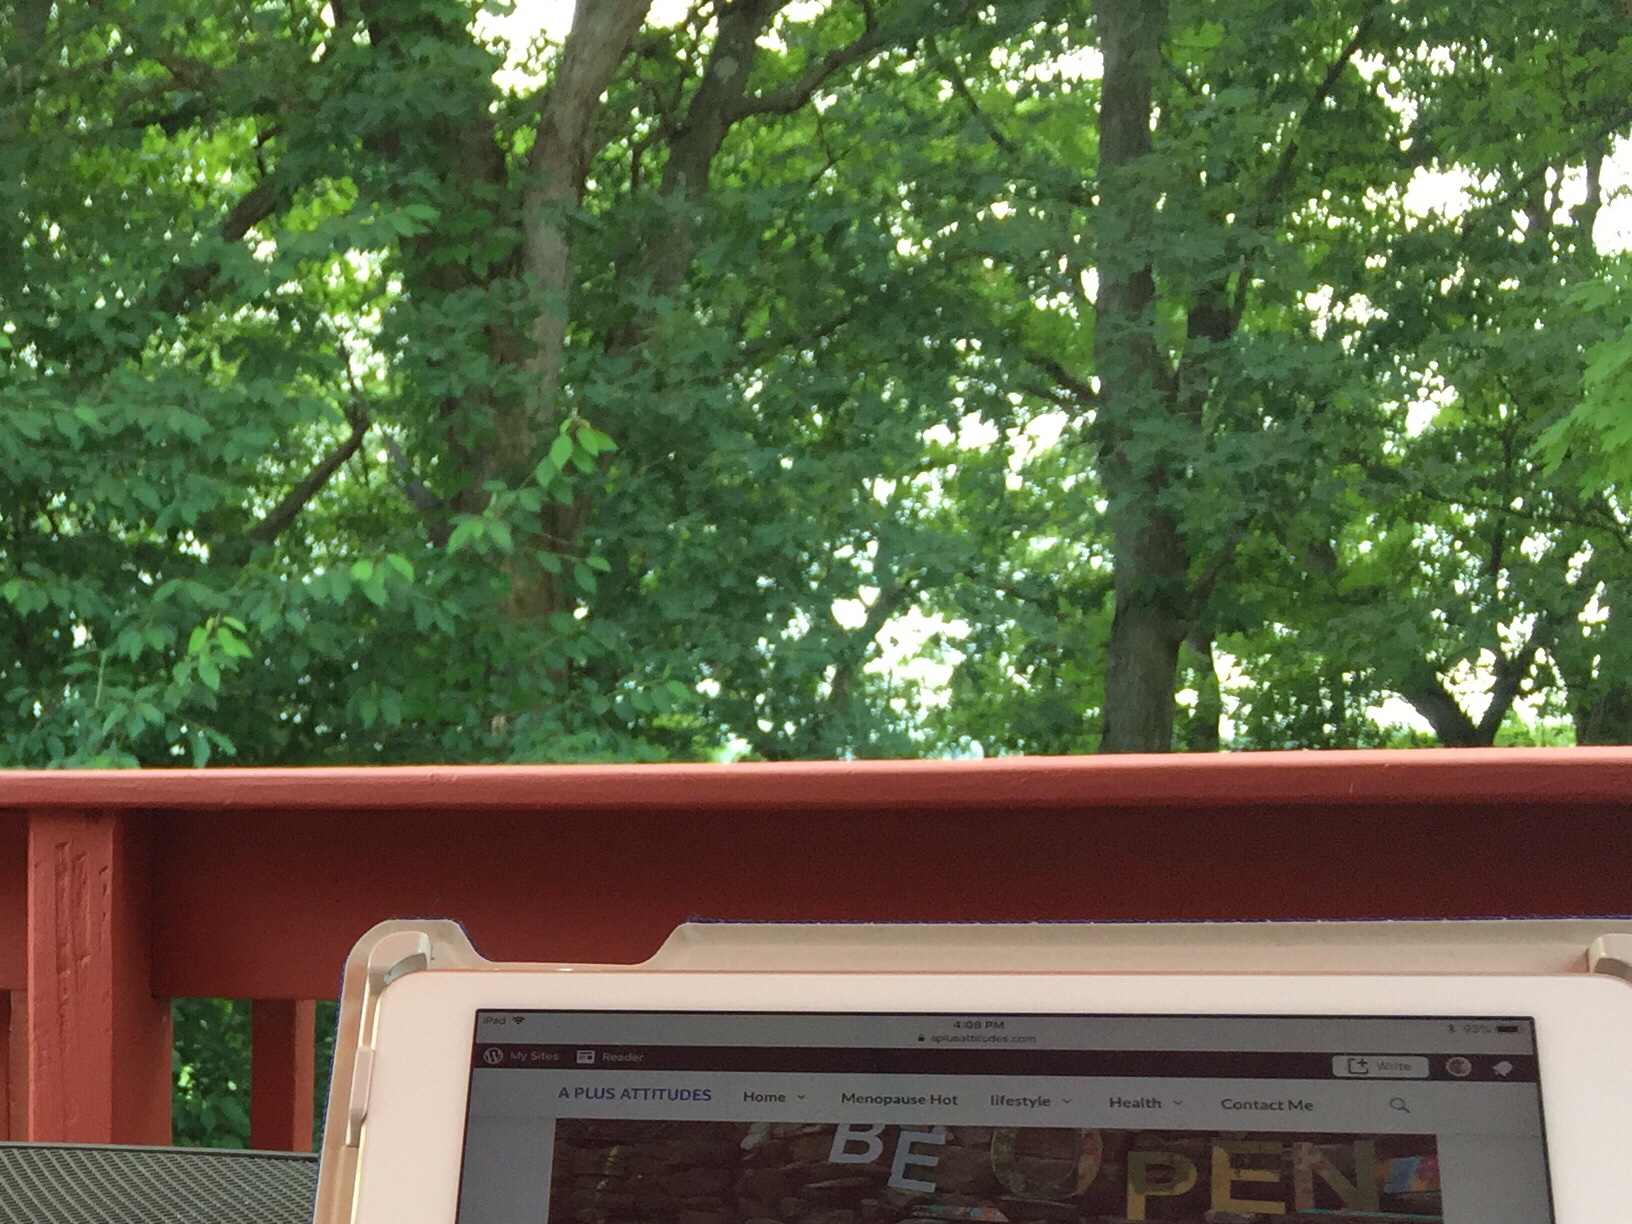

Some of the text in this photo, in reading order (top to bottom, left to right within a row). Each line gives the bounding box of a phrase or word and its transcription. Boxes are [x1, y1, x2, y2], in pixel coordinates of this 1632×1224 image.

[483, 1015, 506, 1026] iPad
[985, 1020, 1005, 1030] PM
[510, 1050, 559, 1062] My Sites
[602, 1051, 644, 1063] Reader
[558, 1087, 712, 1102] A PLUS ATTITUDES
[743, 1091, 786, 1103] Home
[841, 1092, 958, 1107] Menopause Hot
[990, 1094, 1051, 1108] lifestyle
[1109, 1097, 1162, 1110] Health
[1221, 1098, 1314, 1112] Contact Me
[828, 1122, 1381, 1221] BE OPEN
